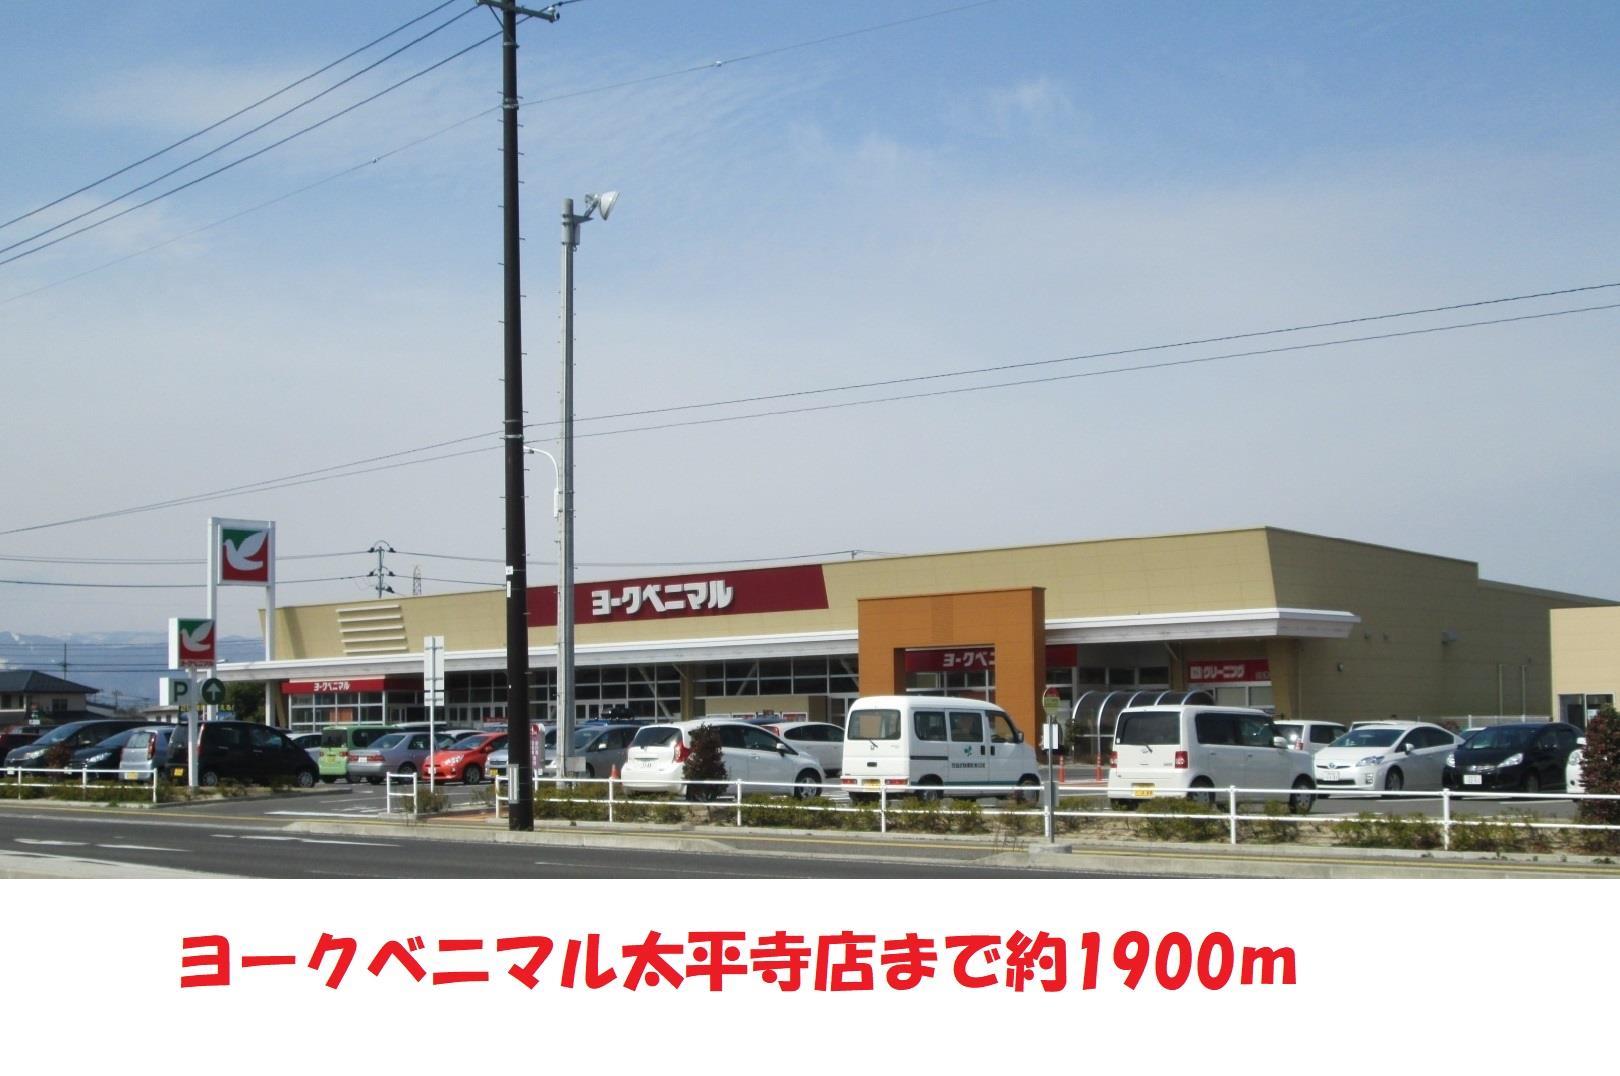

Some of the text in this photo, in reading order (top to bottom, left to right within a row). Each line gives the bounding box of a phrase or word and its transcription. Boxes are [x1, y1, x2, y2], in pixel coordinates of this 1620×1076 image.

[591, 579, 734, 616] ヨークベニマル
[174, 681, 189, 703] P
[313, 681, 351, 692] ヨークベニマル
